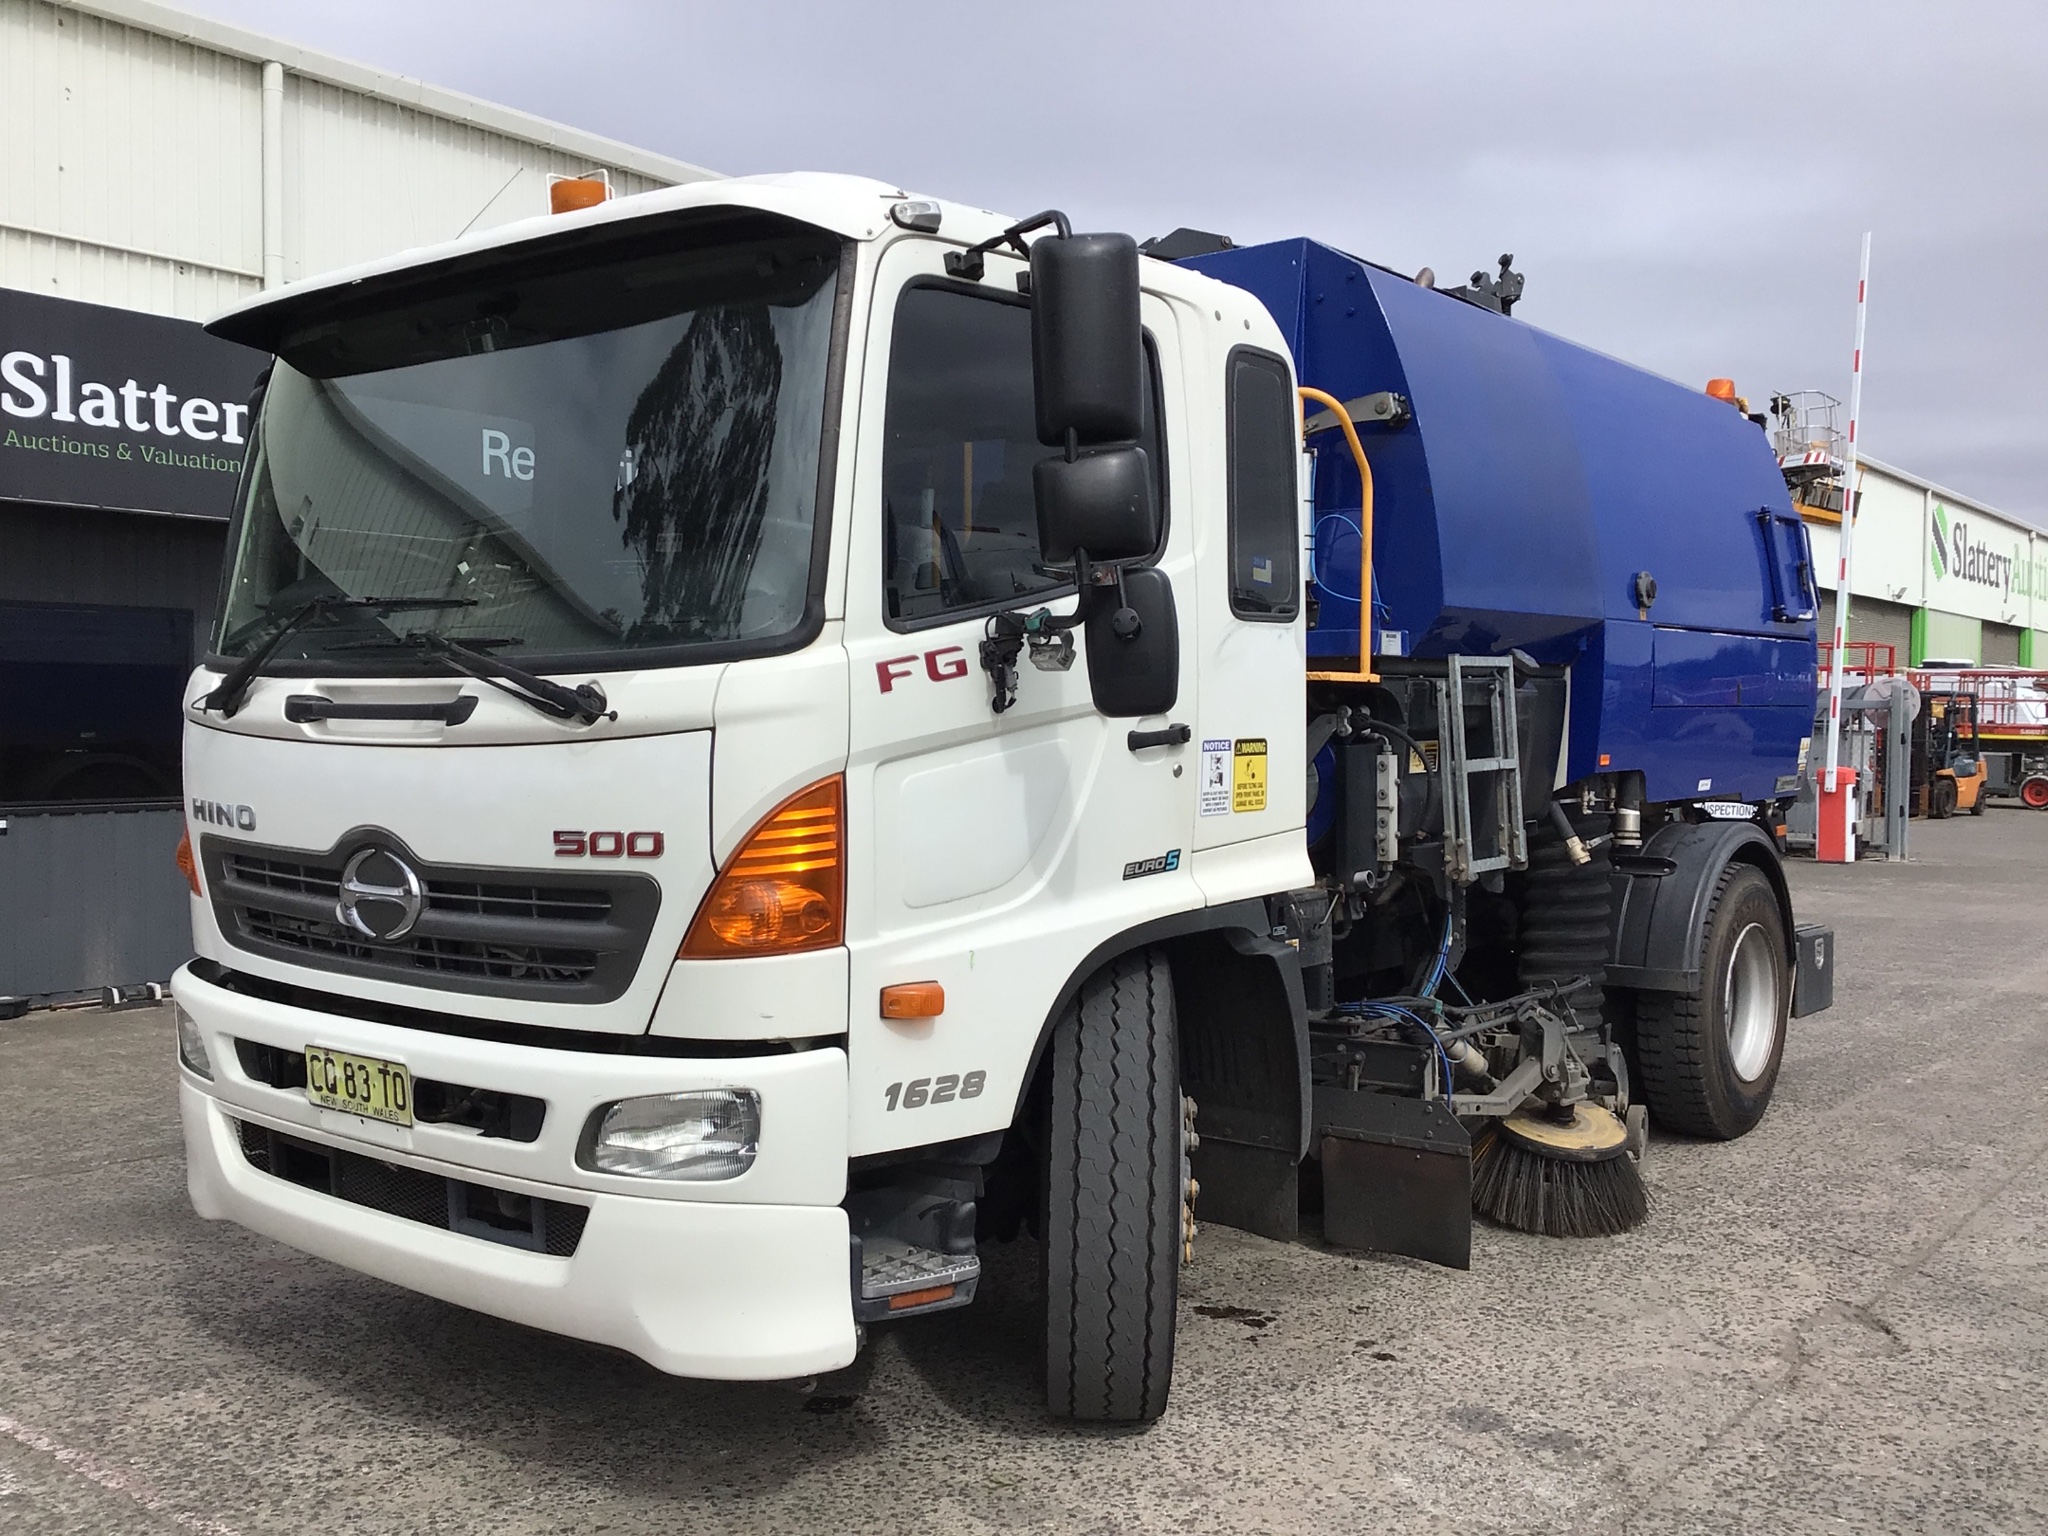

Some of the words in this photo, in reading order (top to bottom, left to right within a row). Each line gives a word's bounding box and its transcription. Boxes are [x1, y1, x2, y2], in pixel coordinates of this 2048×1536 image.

[3, 429, 110, 459] Auctions
[116, 443, 133, 461] &
[1953, 522, 2011, 604] Slattery
[875, 645, 968, 694] FG
[1203, 741, 1230, 751] NOTICE
[1241, 742, 1266, 754] WARNING
[192, 797, 257, 832] HINO
[553, 830, 665, 859] 500
[885, 1069, 987, 1112] 1628
[320, 1095, 338, 1107] NEW
[342, 1099, 369, 1115] SOUTH
[373, 1106, 400, 1122] WALES
